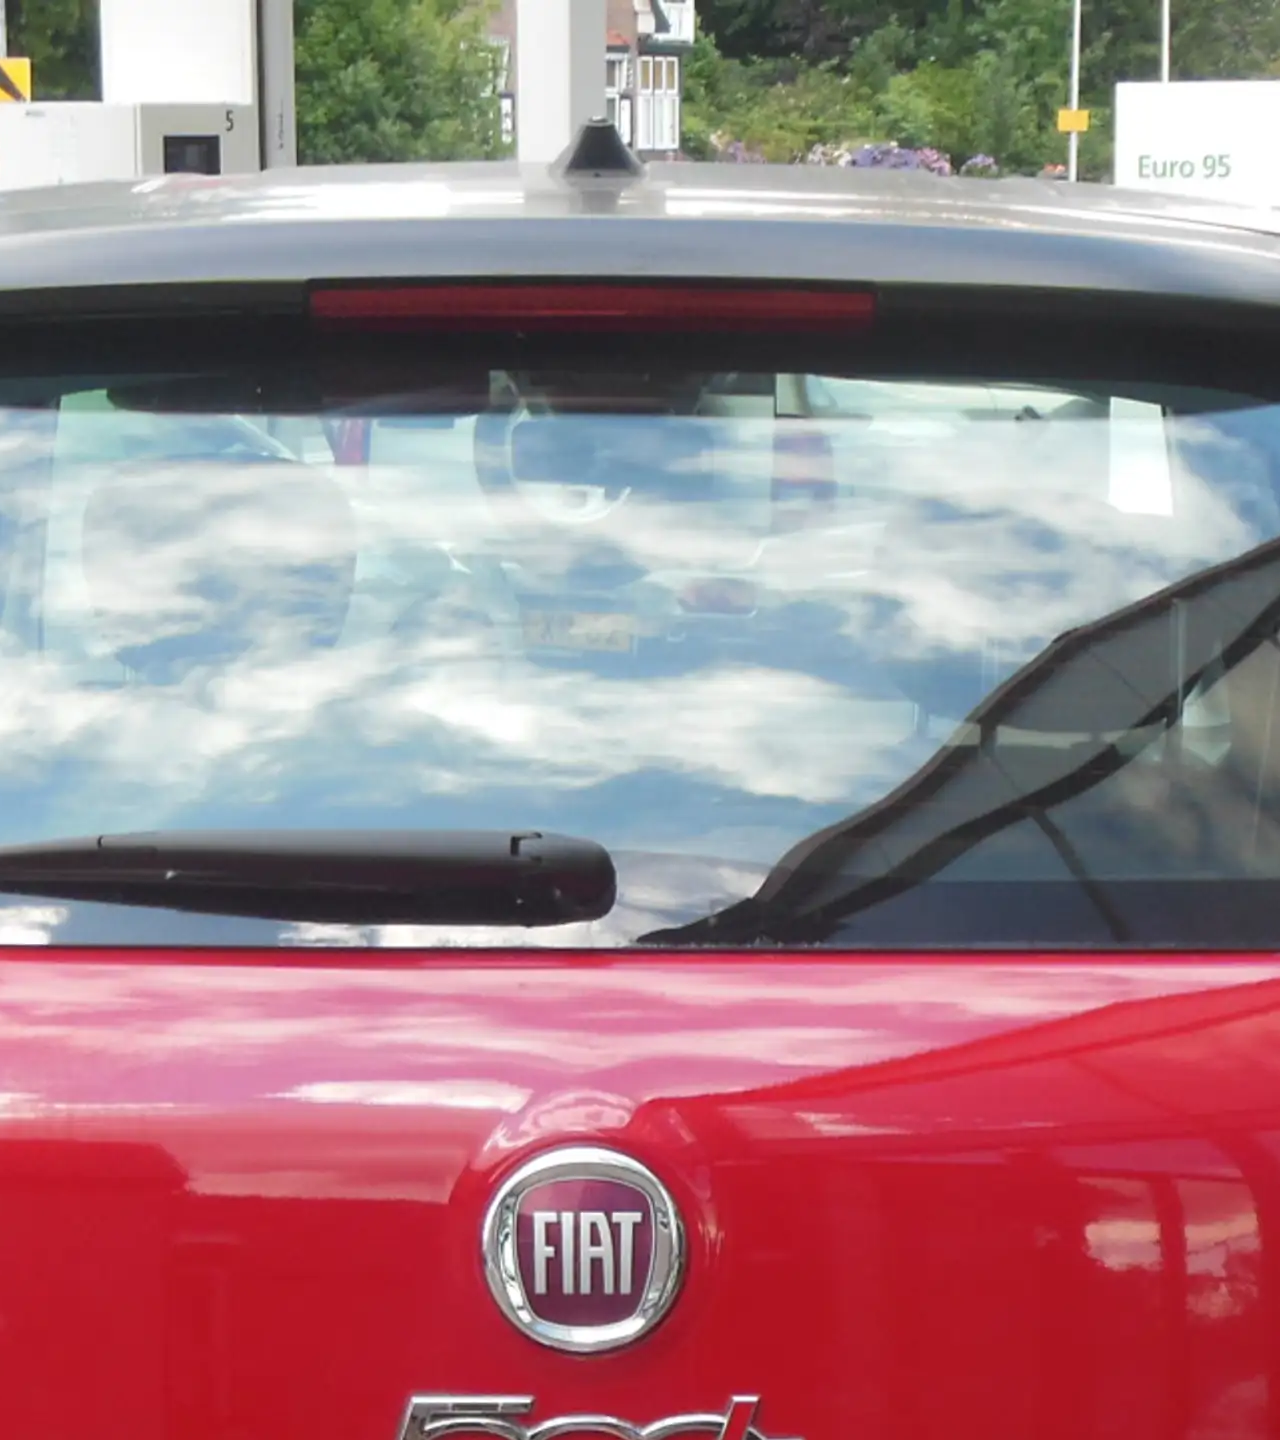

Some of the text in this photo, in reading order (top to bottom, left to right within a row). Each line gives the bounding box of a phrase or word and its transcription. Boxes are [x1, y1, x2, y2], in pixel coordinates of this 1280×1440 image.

[225, 109, 234, 132] 5
[1138, 153, 1232, 179] Euro 95
[533, 1211, 643, 1296] FIAT
